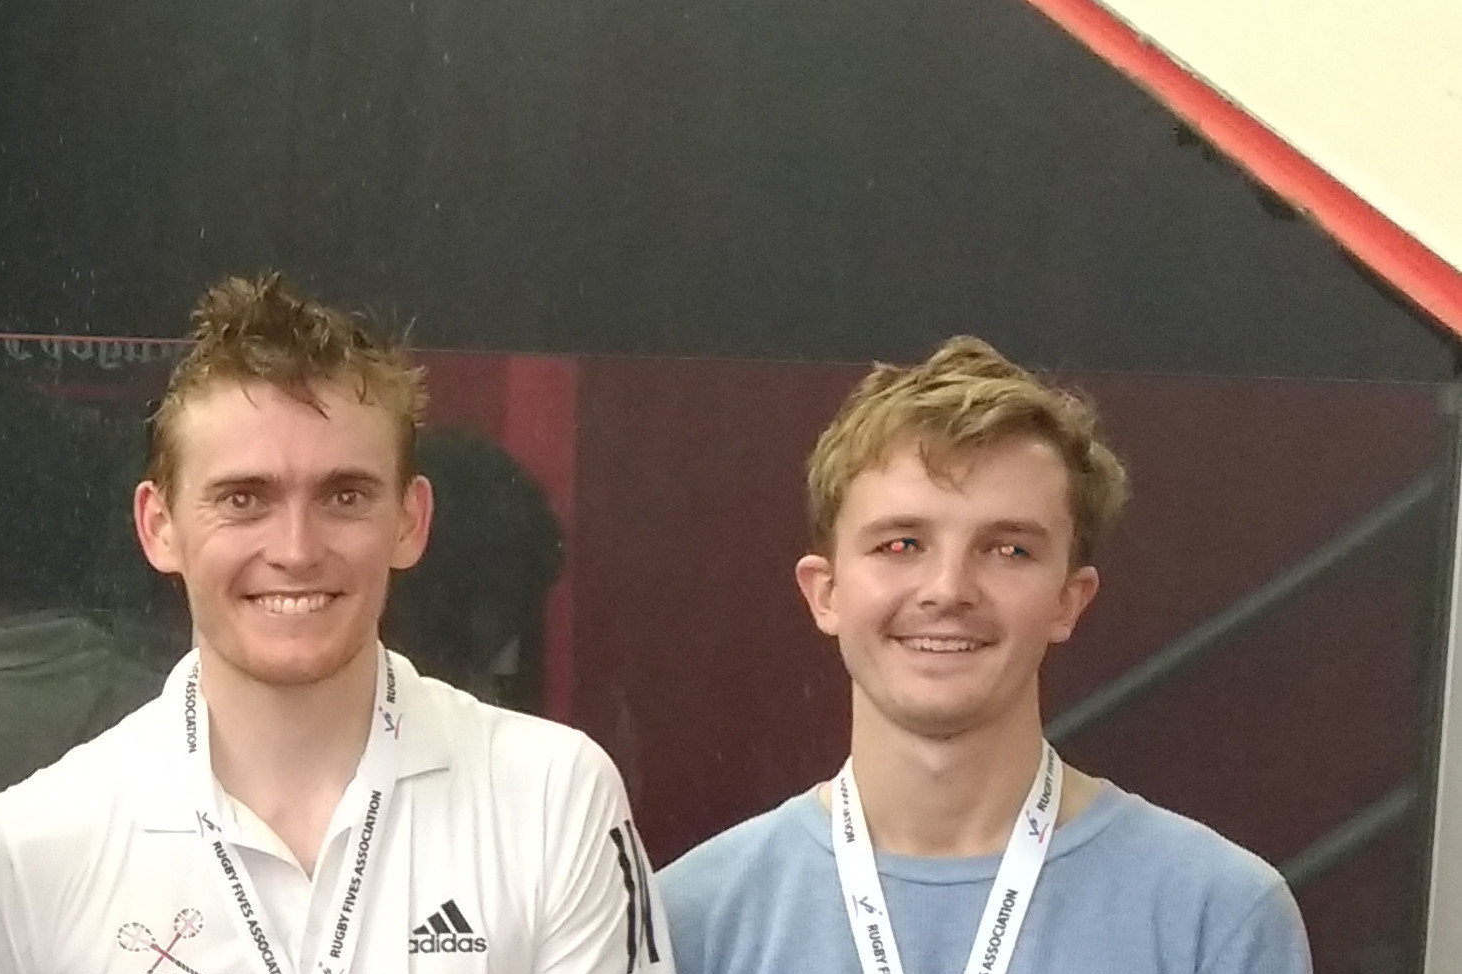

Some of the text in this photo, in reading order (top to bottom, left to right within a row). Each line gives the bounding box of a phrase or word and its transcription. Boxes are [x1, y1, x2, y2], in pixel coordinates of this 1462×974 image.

[185, 681, 197, 753] ASSOCIATION
[212, 840, 239, 881] RUGBY
[232, 882, 255, 918] FIVES
[329, 790, 382, 959] RUGBY FIVES ASSOCIATION
[408, 933, 487, 953] adidas
[866, 923, 888, 964] RUGBY
[982, 888, 1019, 971] ASSOCIATION
